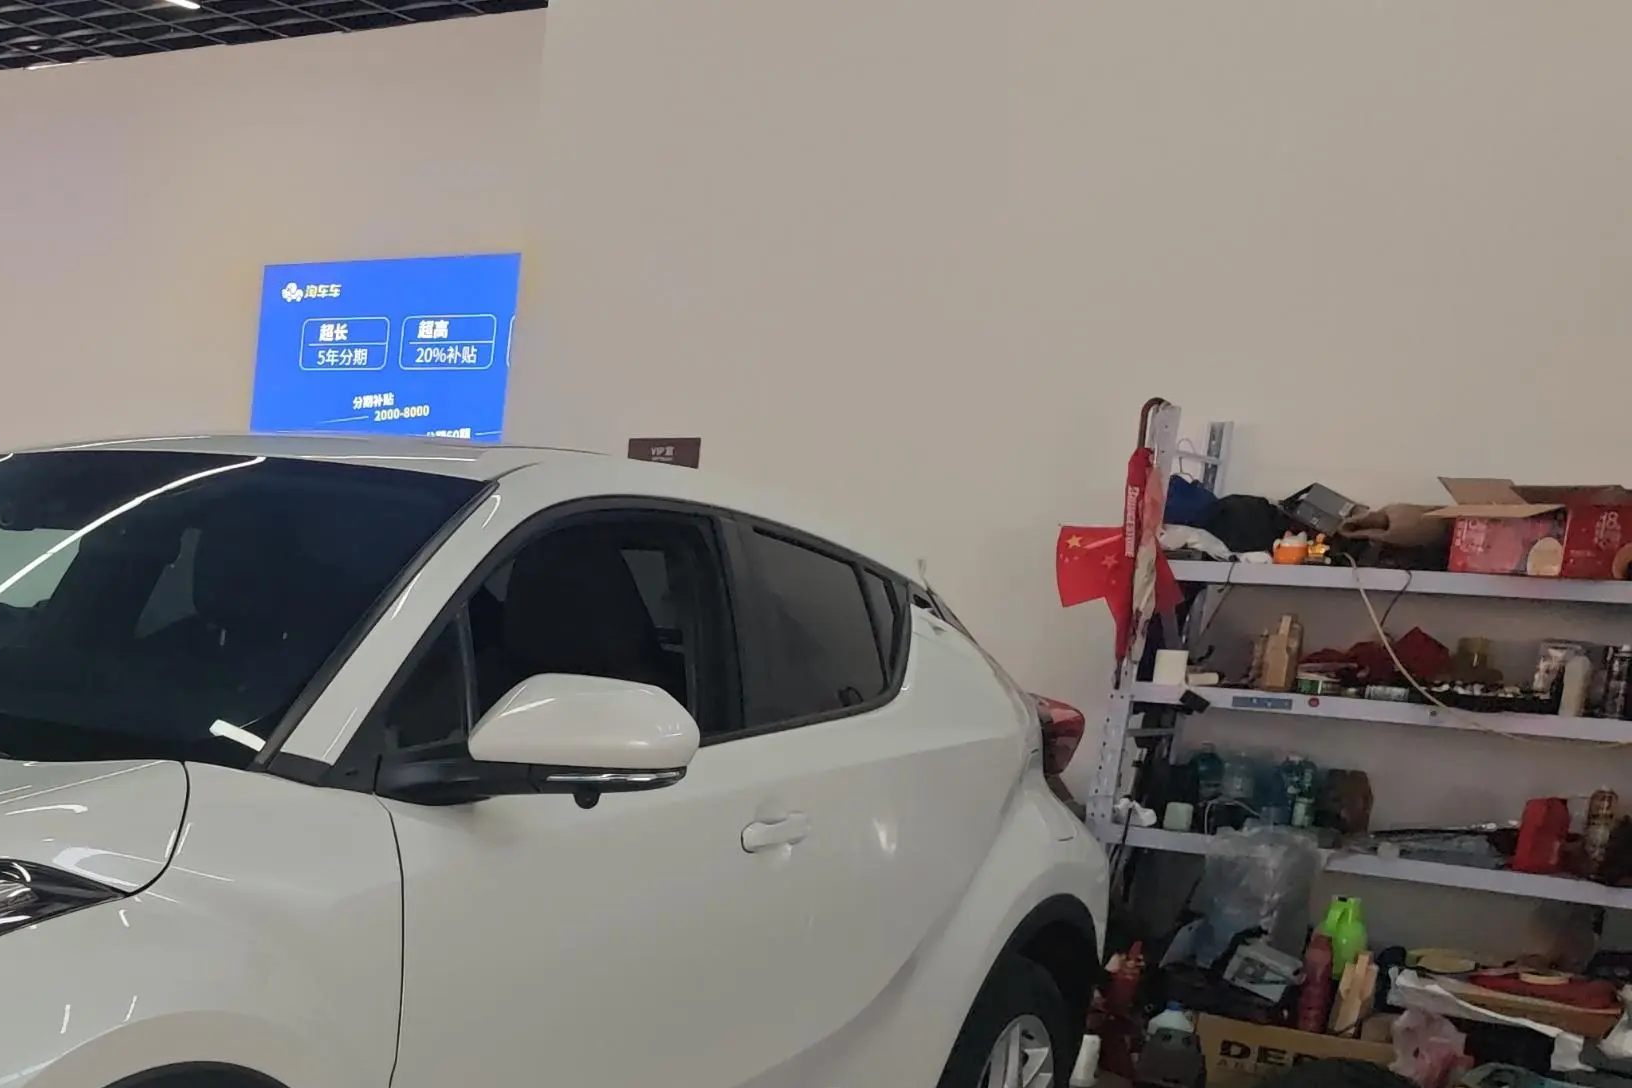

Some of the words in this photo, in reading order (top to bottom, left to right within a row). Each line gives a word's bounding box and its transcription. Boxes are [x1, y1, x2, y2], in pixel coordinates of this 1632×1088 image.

[319, 323, 348, 342] 超长
[417, 320, 449, 339] 超高
[317, 348, 368, 366] 5年分期
[415, 346, 478, 364] 20%补贴
[352, 392, 395, 410] 分期补贴
[374, 405, 430, 421] 2000-8000
